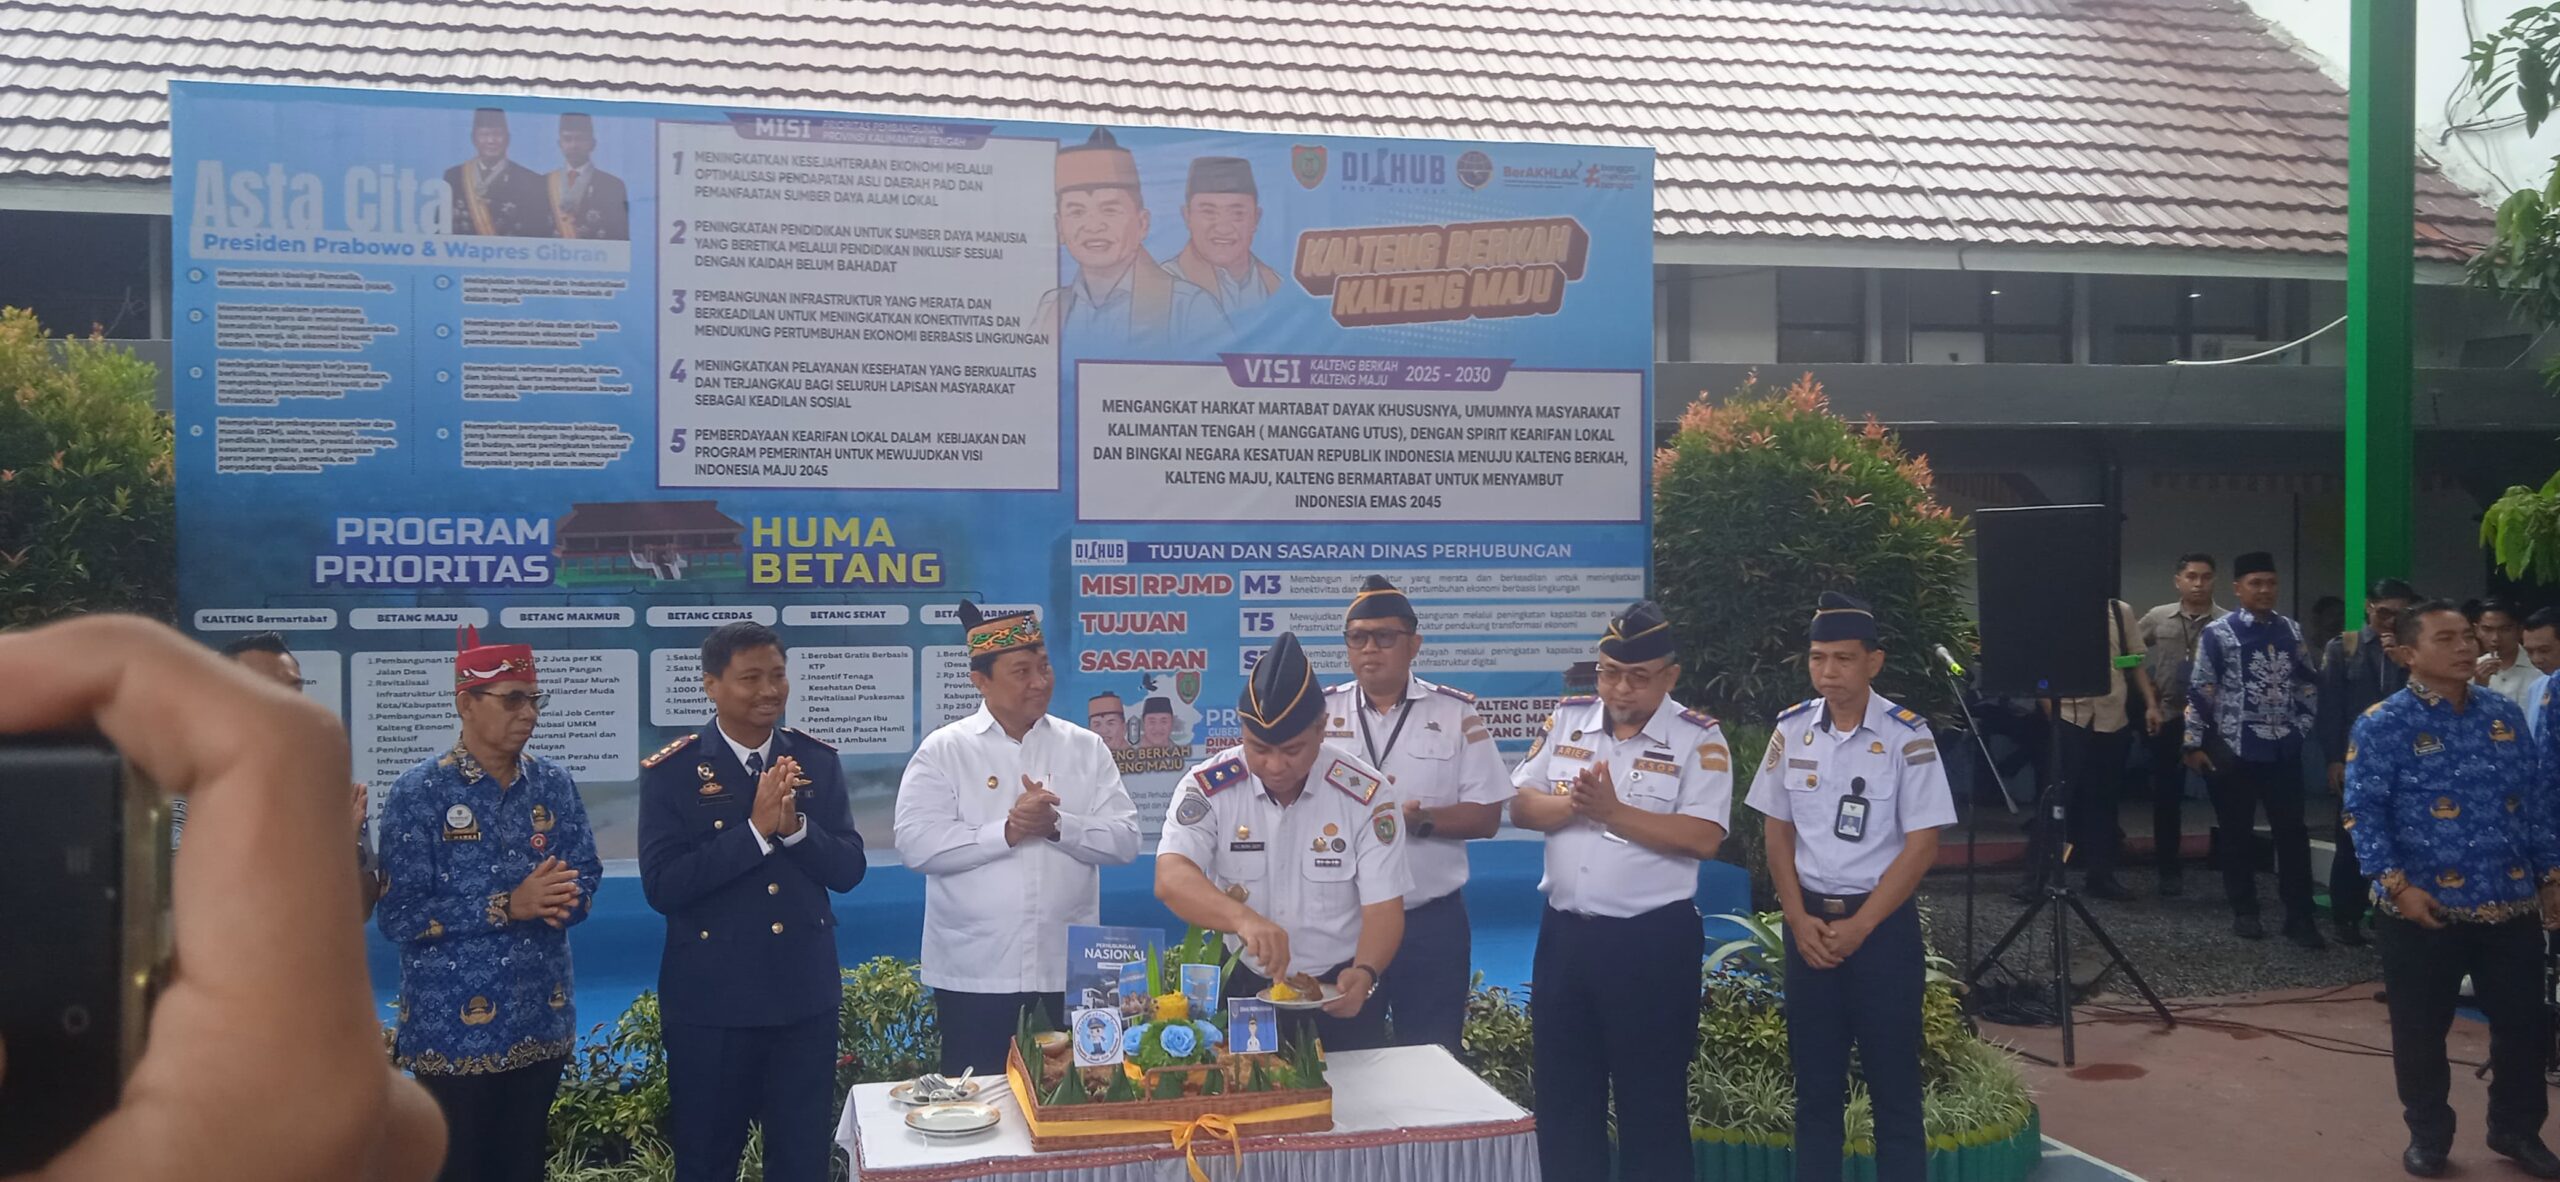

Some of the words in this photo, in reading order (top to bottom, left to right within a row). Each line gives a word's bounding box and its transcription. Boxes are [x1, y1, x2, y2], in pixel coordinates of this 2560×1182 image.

[755, 117, 811, 138] MISI
[193, 160, 323, 231] Asta
[344, 164, 453, 235] Cita
[204, 234, 305, 255] Presiden
[314, 237, 414, 259] Prabowo
[421, 240, 436, 259] &
[444, 242, 528, 263] Wapres
[536, 245, 606, 266] Gibran
[1301, 232, 1441, 277] KALTENG
[1447, 225, 1571, 268] BERKAH
[1337, 272, 1465, 315] KALTENG
[1470, 268, 1554, 307] MAJU
[670, 359, 686, 383] 4
[695, 360, 788, 373] MENINGKATKAN
[792, 361, 858, 375] PELAYANAN
[862, 363, 926, 376] KESEHATAN
[929, 364, 961, 376] YANG
[964, 365, 1036, 378] BERKUALITAS
[1243, 358, 1301, 383] VISI
[1310, 360, 1354, 372] KALTENG
[1358, 360, 1398, 373] BERKAH
[1405, 366, 1439, 382] 2025
[1455, 366, 1491, 383] 2030
[695, 377, 720, 389] DAN
[724, 378, 801, 391] TERJANGKAU
[805, 379, 833, 391] BAGI
[836, 379, 887, 392] SELURUH
[890, 380, 937, 393] LAPISAN
[940, 381, 1015, 394] MASYARAKAT
[1310, 373, 1355, 385] KALTENG
[1359, 374, 1388, 386] MAJU
[695, 394, 745, 407] SEBAGAI
[749, 395, 806, 408] KEADILAN
[810, 396, 851, 408] SOSIAL
[1102, 400, 1197, 415] MENGANGKAT
[1201, 401, 1255, 415] HARKAT
[1258, 402, 1329, 416] MARTABAT
[1332, 403, 1375, 417] DAYAK
[1378, 403, 1461, 418] KHUSUSNYA,
[1465, 404, 1532, 419] UMUMNYA
[1535, 405, 1620, 420] MASYARAKAT
[1108, 423, 1197, 438] KALIMANTAN
[1200, 424, 1255, 438] TENGAH
[1267, 425, 1360, 439] MANGGATANG
[1363, 426, 1407, 440] UTUS),
[1410, 426, 1463, 441] DENGAN
[1466, 427, 1507, 441] SPIRIT
[1510, 427, 1572, 442] KEARIFAN
[1574, 428, 1615, 442] LOKAL
[670, 429, 686, 453] 5
[695, 429, 788, 442] PEMBERDAYAAN
[792, 430, 848, 443] KEARIFAN
[851, 431, 888, 443] LOKAL
[891, 432, 931, 444] DALAM
[937, 432, 999, 445] KEBIJAKAN
[1001, 433, 1026, 445] DAN
[695, 447, 756, 459] PROGRAM
[759, 447, 831, 460] PEMERINTAH
[835, 448, 873, 460] UNTUK
[876, 448, 959, 461] MEWUJUDKAN
[961, 449, 982, 461] VISI
[1093, 447, 1122, 461] DAN
[1126, 447, 1182, 461] BINGKAI
[1185, 447, 1240, 461] NEGARA
[1243, 448, 1314, 462] KESATUAN
[1317, 448, 1381, 462] REPUBLIK
[1384, 449, 1455, 463] INDONESIA
[1458, 449, 1512, 463] MENUJU
[1515, 450, 1571, 464] KALTENG
[1574, 450, 1628, 464] BERKAH,
[695, 464, 760, 476] INDONESIA
[763, 465, 796, 476] MAJU
[799, 465, 828, 476] 2045
[1165, 472, 1226, 485] KALTENG
[1229, 472, 1272, 485] MAJU,
[1275, 472, 1334, 486] KALTENG
[1337, 472, 1432, 486] BERMARTABAT
[1435, 473, 1479, 486] UNTUK
[1482, 473, 1564, 487] MENYAMBUT
[1295, 495, 1367, 508] INDONESIA
[1370, 495, 1407, 509] EMAS
[1410, 495, 1441, 509] 2045
[336, 517, 550, 545] PROGRAM
[753, 516, 895, 548] HUMA
[1148, 545, 1224, 559] TUJUAN
[1231, 544, 1271, 559] DAN
[1277, 544, 1364, 559] SASARAN
[1371, 544, 1427, 559] DINAS
[1433, 543, 1571, 558] PERHUBUNGAN
[315, 555, 549, 583] PRIORITAS
[753, 552, 941, 584] BETANG
[1081, 575, 1137, 595] MISI
[1142, 575, 1232, 594] RPJMD
[1244, 575, 1281, 594] M3
[1409, 585, 1464, 595] pertumbuhan
[1466, 585, 1499, 594] ekonomi
[1502, 585, 1535, 594] berbasis
[1537, 584, 1579, 594] lingkungan
[202, 614, 253, 624] KALTENG
[256, 614, 327, 624] Bermartabat
[377, 613, 421, 623] BETANG
[424, 613, 458, 622] MAJU
[520, 612, 564, 622] BETANG
[567, 612, 620, 622] MAKMUR
[667, 611, 709, 620] BETANG
[712, 611, 752, 620] CERDAS
[810, 611, 851, 620] BETANG
[853, 610, 886, 619] SEHAT
[1080, 613, 1186, 633] TUJUAN
[1243, 612, 1274, 631] T5
[1445, 622, 1489, 630] pendukung
[1491, 621, 1541, 630] transformasi
[1544, 621, 1577, 630] ekonomi
[1081, 651, 1205, 671] SASARAN
[1476, 701, 1528, 710] ALTENG
[1206, 739, 1243, 747] DINAS
[1139, 747, 1190, 758] BERKAH
[1558, 746, 1589, 759] ARIEF
[1147, 760, 1184, 770] MAJU
[1638, 761, 1676, 773] KSOP
[1084, 948, 1147, 961] NASIONAL
